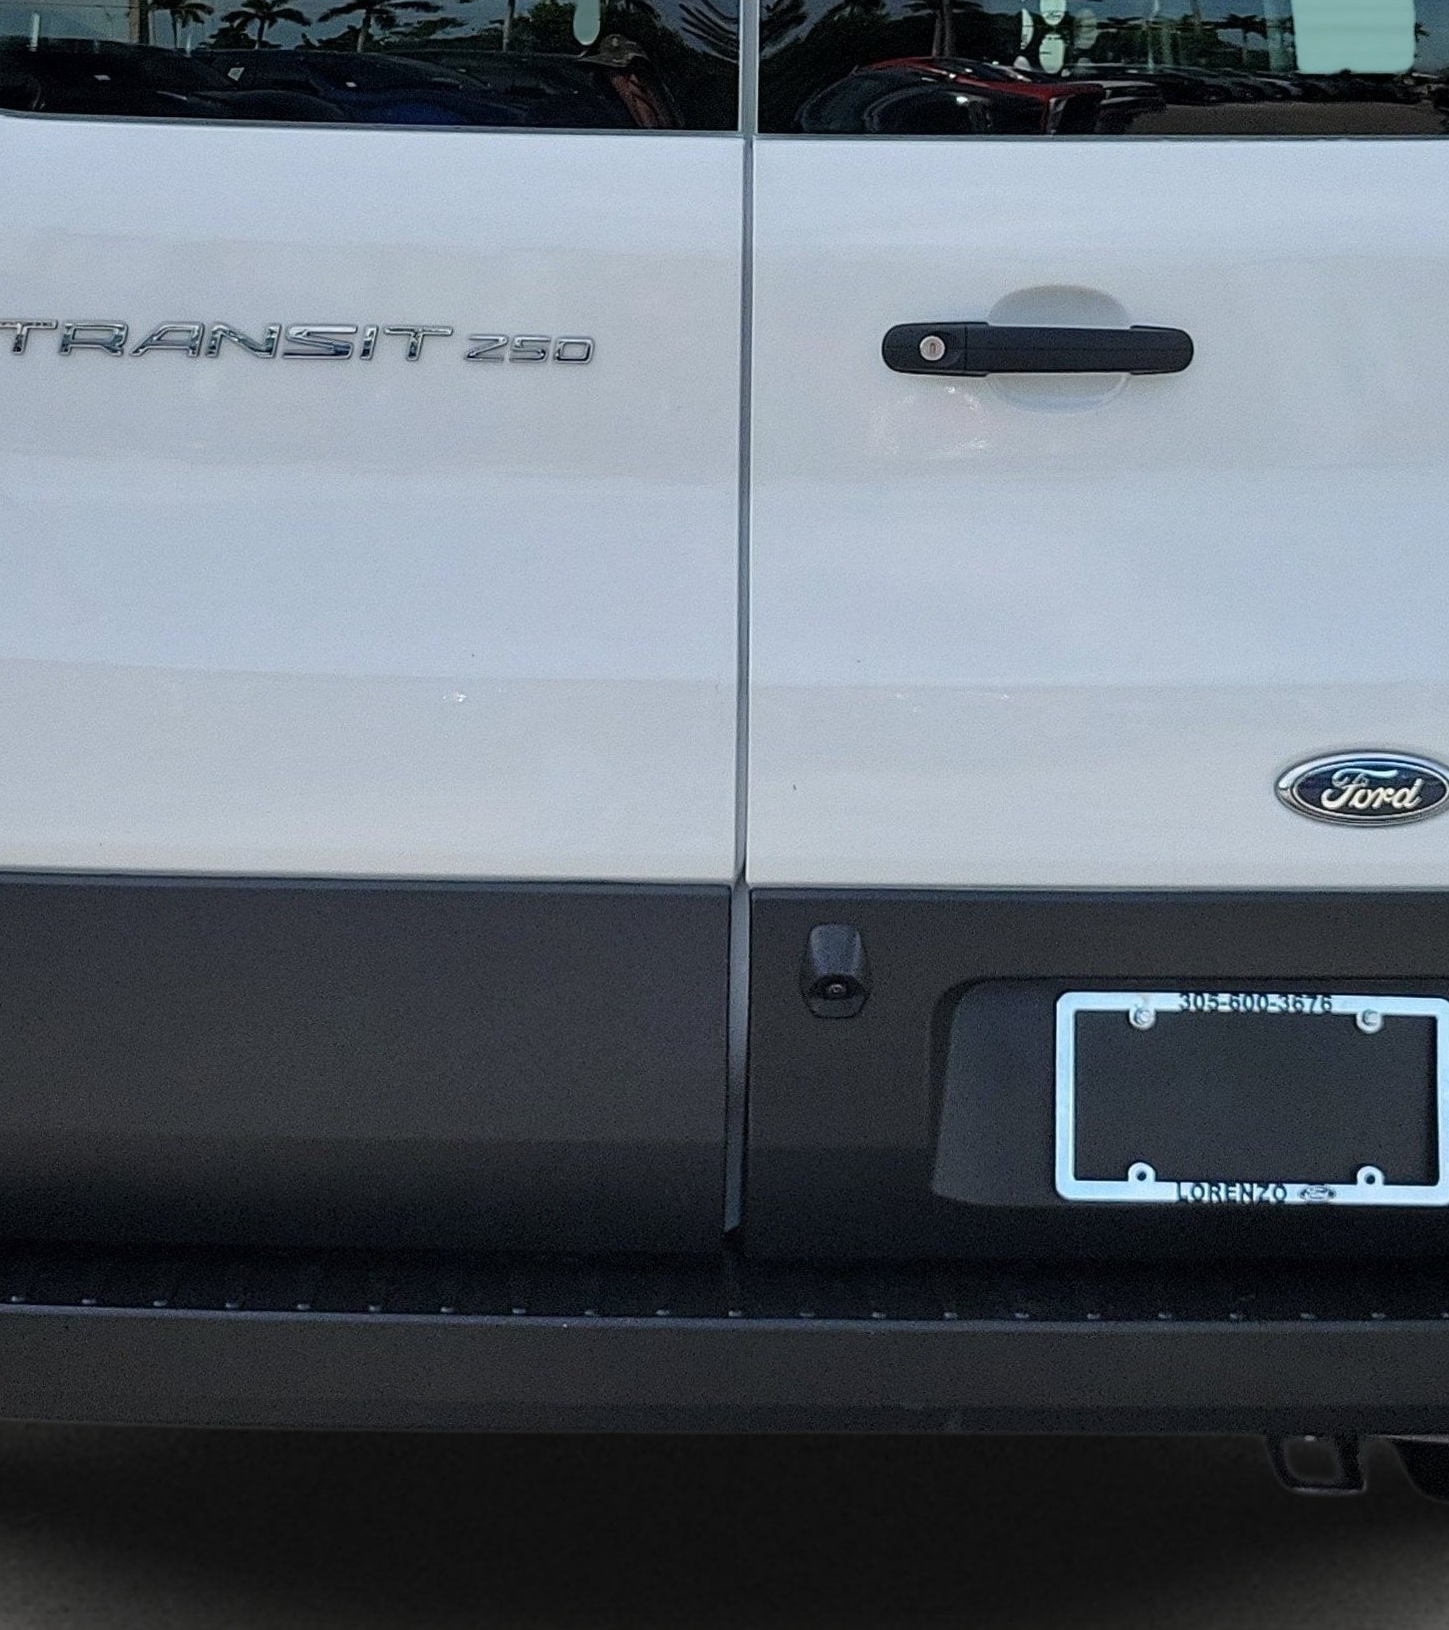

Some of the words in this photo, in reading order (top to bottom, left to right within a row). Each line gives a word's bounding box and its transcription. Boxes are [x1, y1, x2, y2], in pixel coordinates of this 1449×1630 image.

[463, 334, 597, 364] 250
[1319, 767, 1424, 810] Ford
[1178, 992, 1334, 1013] 305-600-3676
[1176, 1182, 1287, 1204] LORENZO
